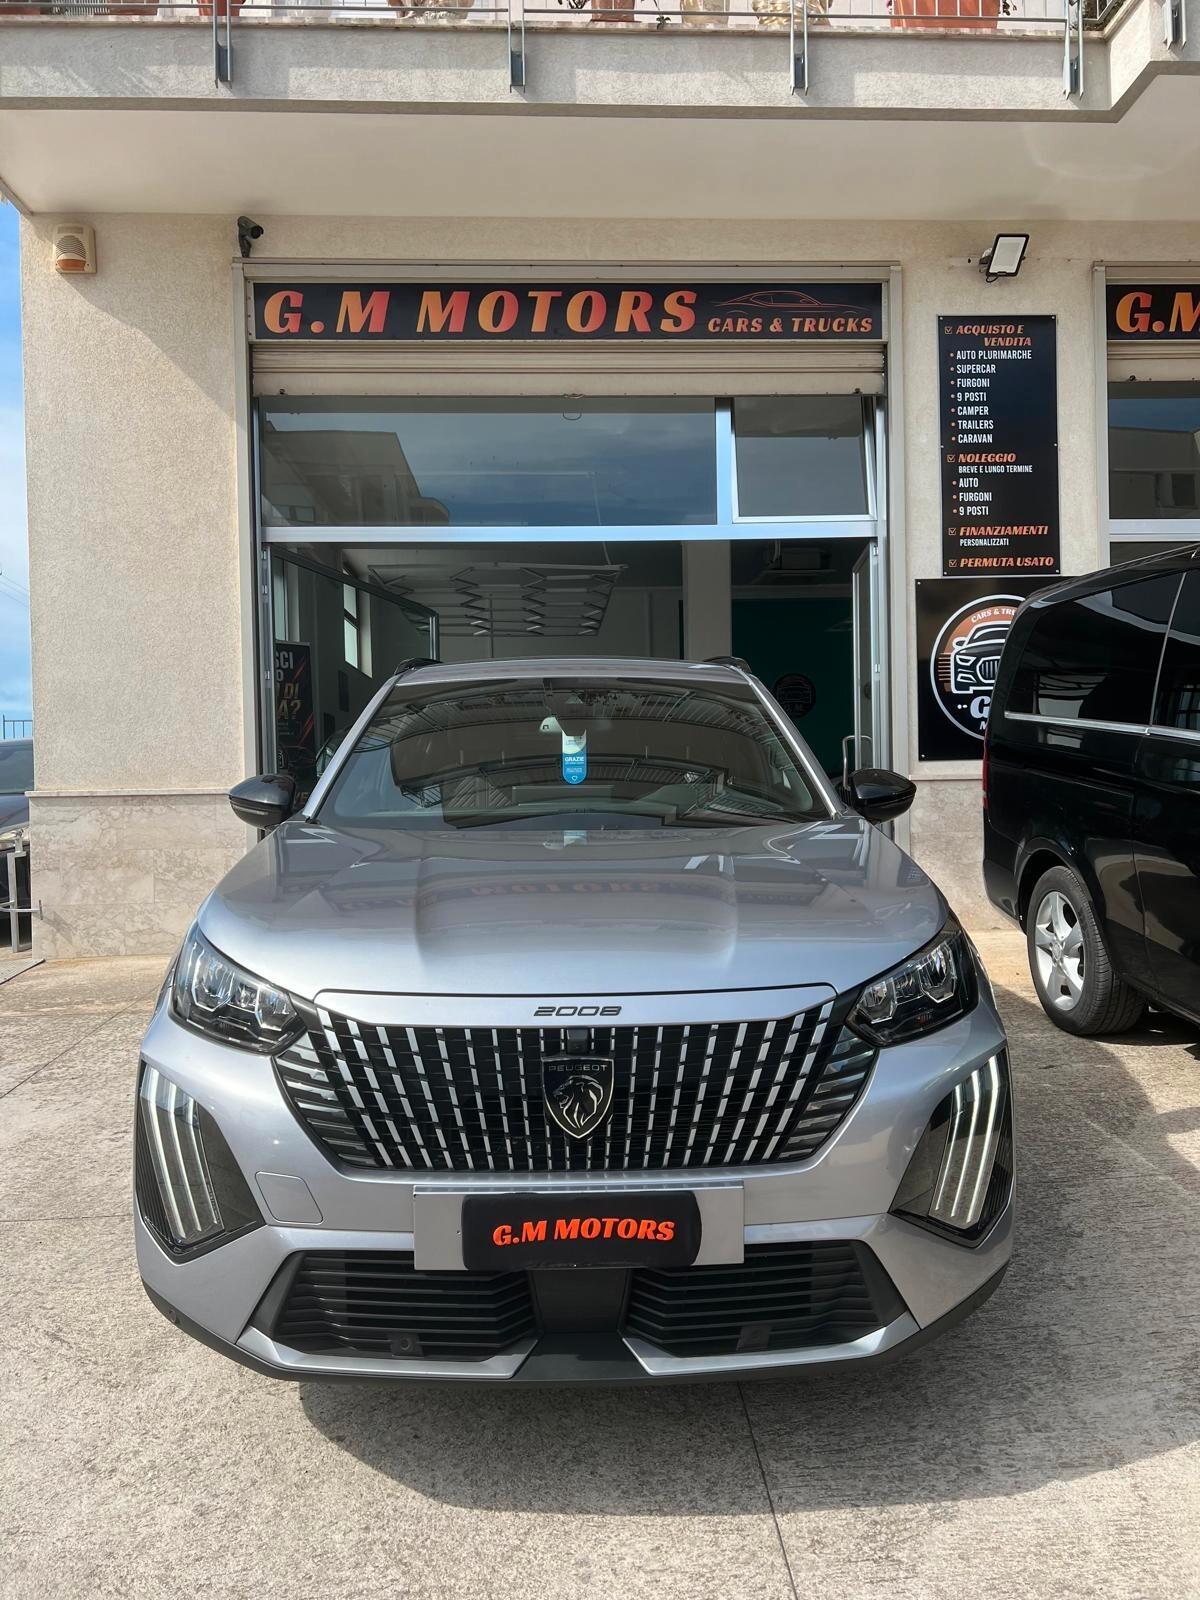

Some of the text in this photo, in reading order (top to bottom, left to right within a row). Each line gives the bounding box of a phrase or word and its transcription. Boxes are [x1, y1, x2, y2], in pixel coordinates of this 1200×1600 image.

[264, 290, 697, 333] G.M MOTORS
[707, 317, 873, 333] CARS & TRUCKS
[956, 325, 1025, 336] ACQUISTO E
[984, 337, 1032, 346] VENDITA
[956, 350, 1032, 360] AUTO PLURIMARCHE
[956, 364, 996, 374] SUPERCAR
[957, 378, 990, 388] FURGONI
[957, 392, 987, 401] 9 POSTI
[957, 406, 989, 416] CAMPER
[958, 420, 994, 430] TRAILERS
[958, 434, 993, 443] CARAVAN
[958, 453, 1016, 463] NOLEGGIO
[958, 465, 978, 474] BREVE
[985, 465, 1005, 473] LUNGO
[1006, 465, 1033, 473] TERMINE
[959, 478, 979, 488] AUTO
[959, 492, 992, 502] FURGONI
[959, 506, 989, 516] 9 POSTI
[960, 525, 1049, 536] FINANZIAMENTI
[960, 538, 1009, 547] PERSONALIZZATI
[960, 556, 1054, 568] PERMUTA USATO
[971, 609, 992, 623] CARS
[534, 1006, 622, 1017] 2008
[493, 1217, 675, 1246] G.M MOTORS
